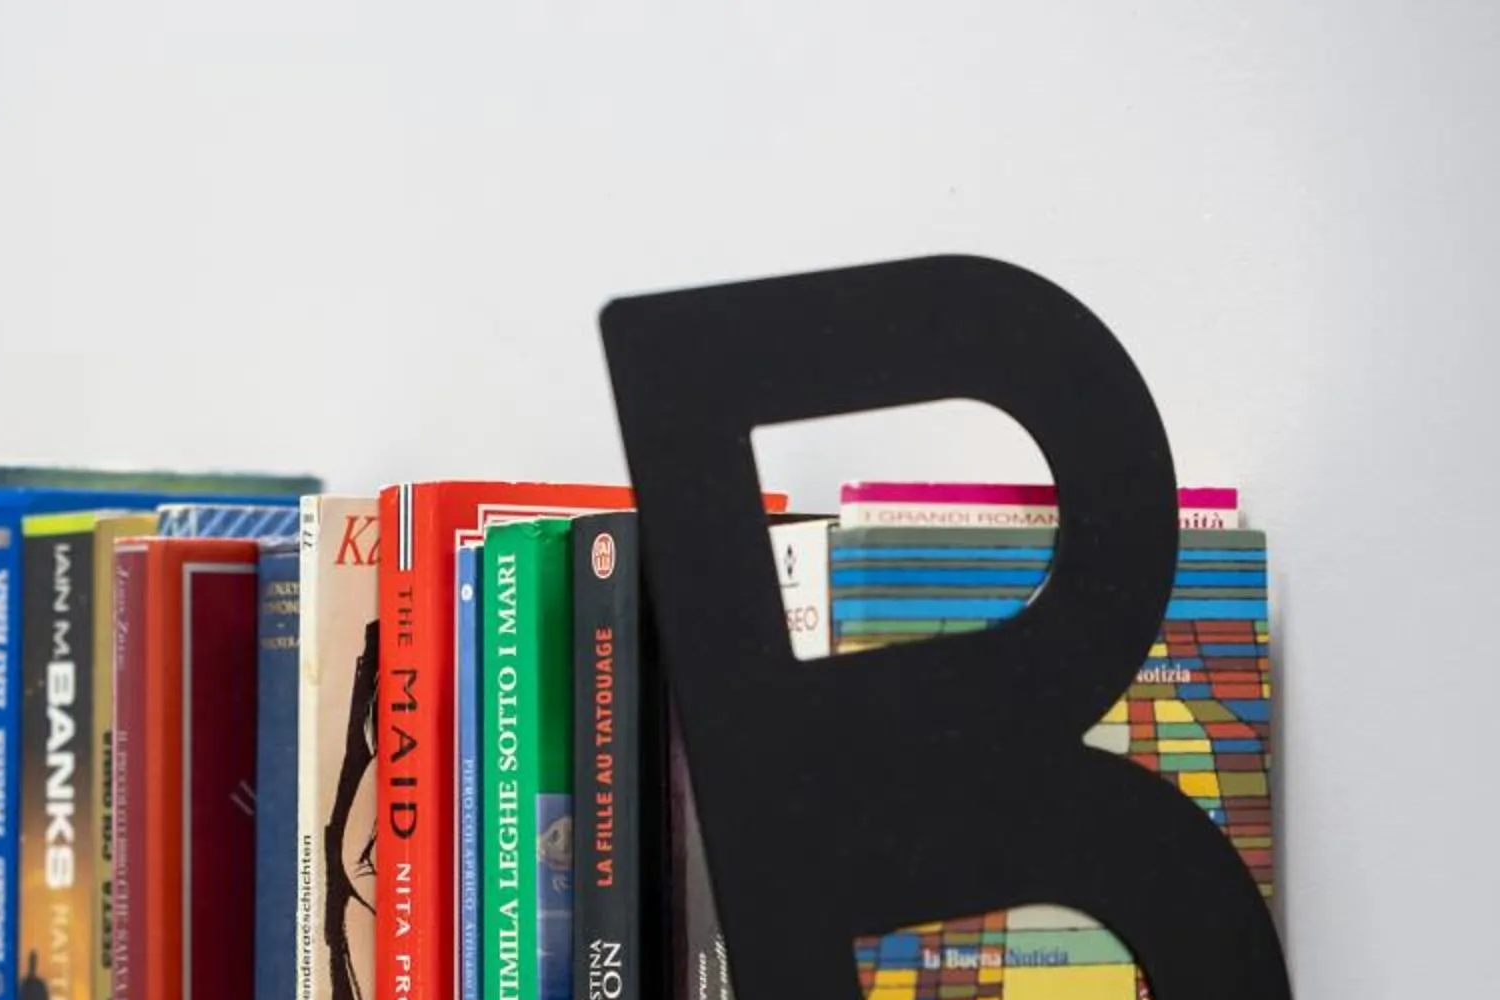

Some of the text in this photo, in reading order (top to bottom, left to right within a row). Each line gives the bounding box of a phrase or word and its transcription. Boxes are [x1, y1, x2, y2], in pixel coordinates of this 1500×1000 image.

[878, 510, 970, 524] GRANDI
[53, 543, 71, 613] IAIN
[497, 553, 517, 635] MARI
[497, 644, 517, 658] I
[390, 585, 419, 840] THE MAID
[497, 666, 518, 771] SOTTO
[44, 661, 76, 891] BANKS
[461, 758, 476, 810] PIERO
[596, 627, 613, 887] LA FILLE AU TATOUAGE
[498, 779, 519, 894] LEGHE
[394, 862, 412, 938] NITA
[923, 948, 941, 969] la
[945, 947, 1002, 969] Buena
